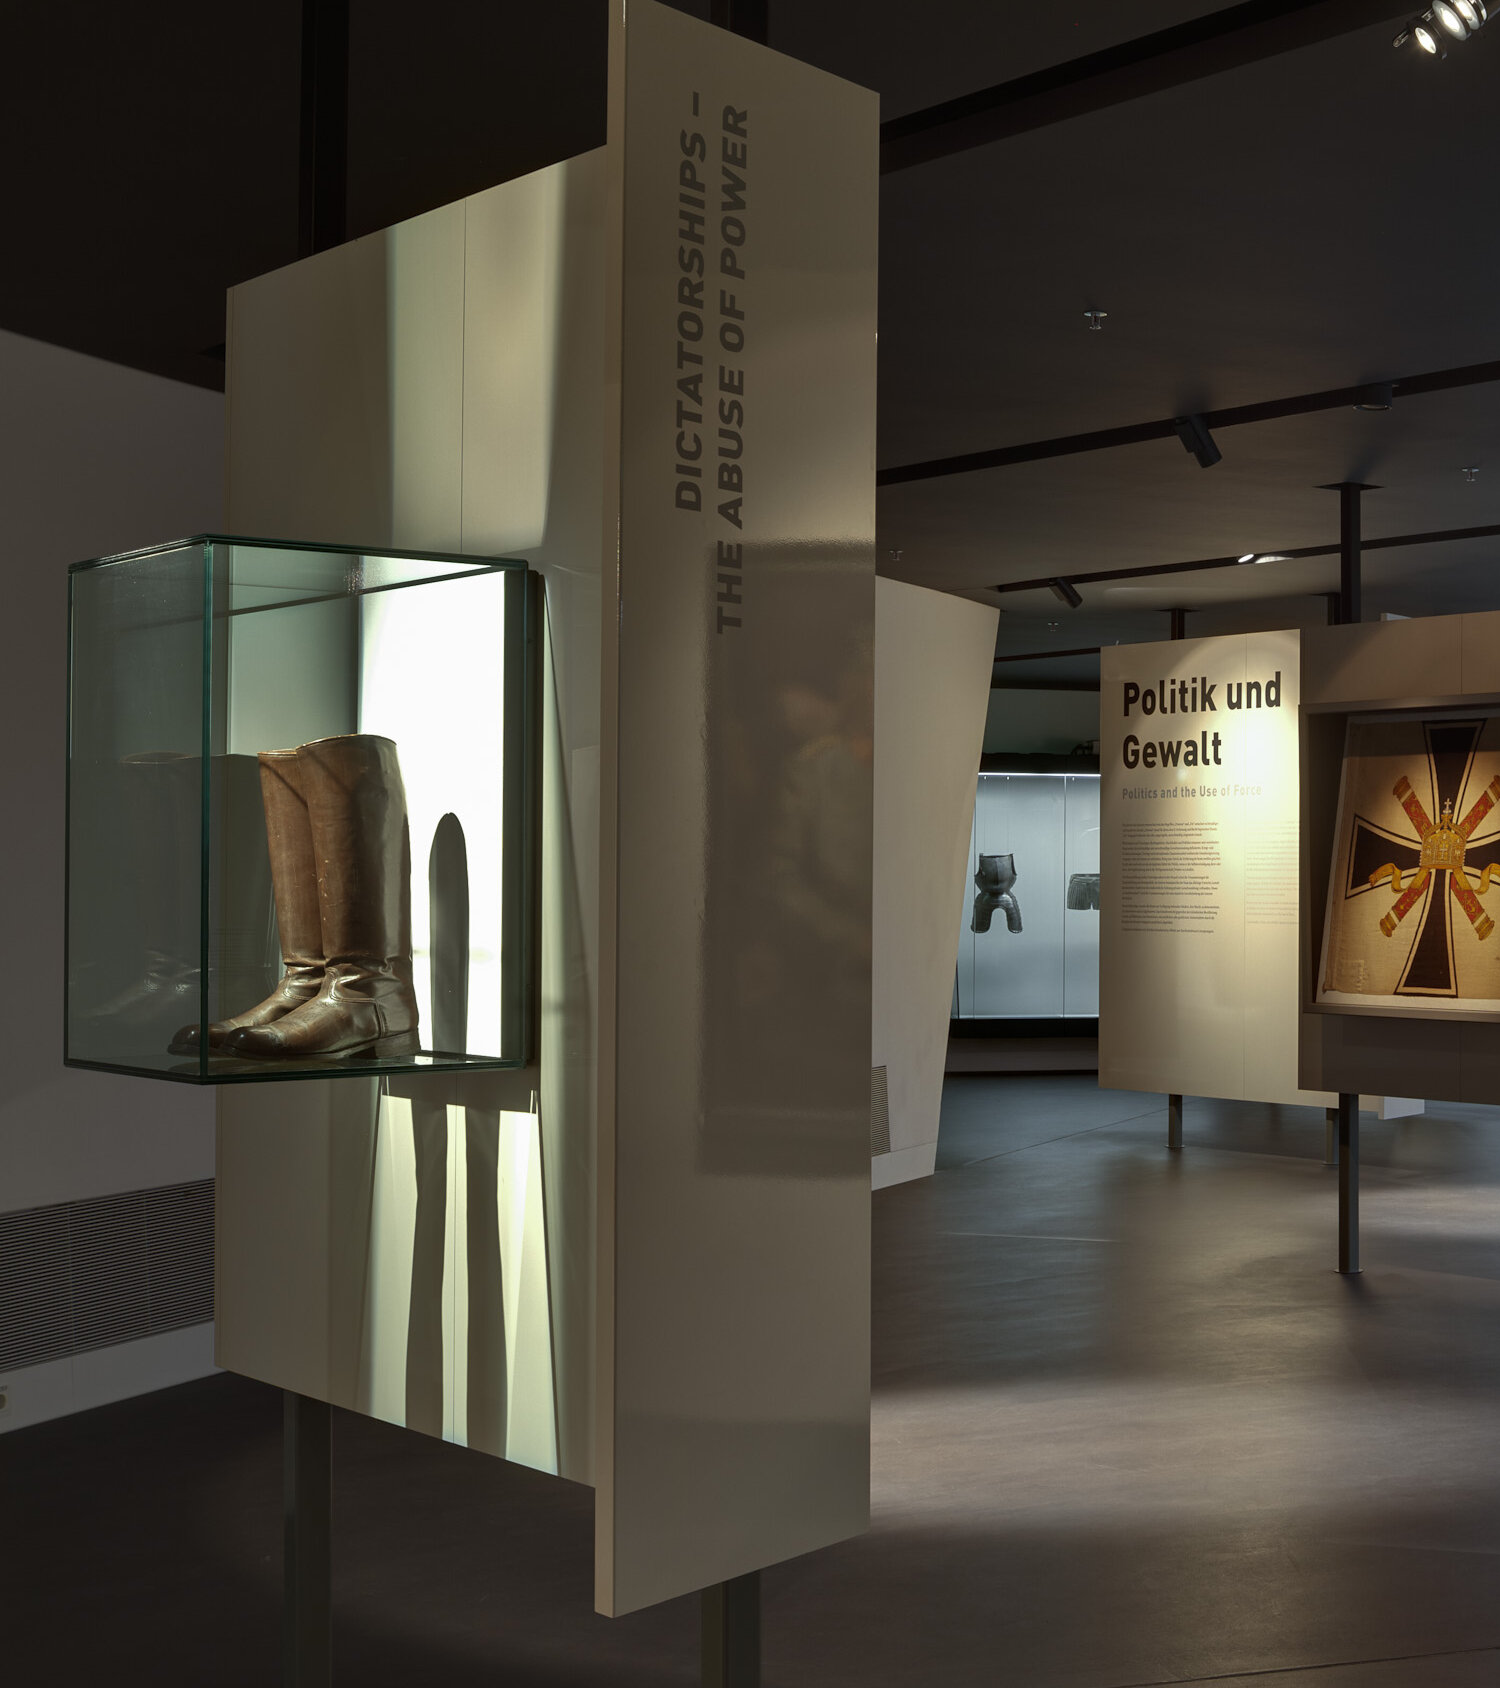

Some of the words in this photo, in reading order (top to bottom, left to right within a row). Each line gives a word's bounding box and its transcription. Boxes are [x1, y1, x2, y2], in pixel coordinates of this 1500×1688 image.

[720, 104, 748, 280] POWER
[675, 129, 707, 512] DICTATORSHIPS
[718, 289, 746, 353] OF
[717, 365, 744, 530] ABUSE
[716, 540, 743, 634] THE
[1123, 676, 1218, 717] Politik
[1226, 671, 1282, 710] und
[1122, 730, 1222, 769] Gewalt
[1122, 787, 1158, 800] Politics
[1160, 786, 1178, 799] and
[1181, 786, 1197, 798] the
[1199, 785, 1218, 797] Use
[1220, 784, 1232, 797] of
[1233, 783, 1263, 797] Force
